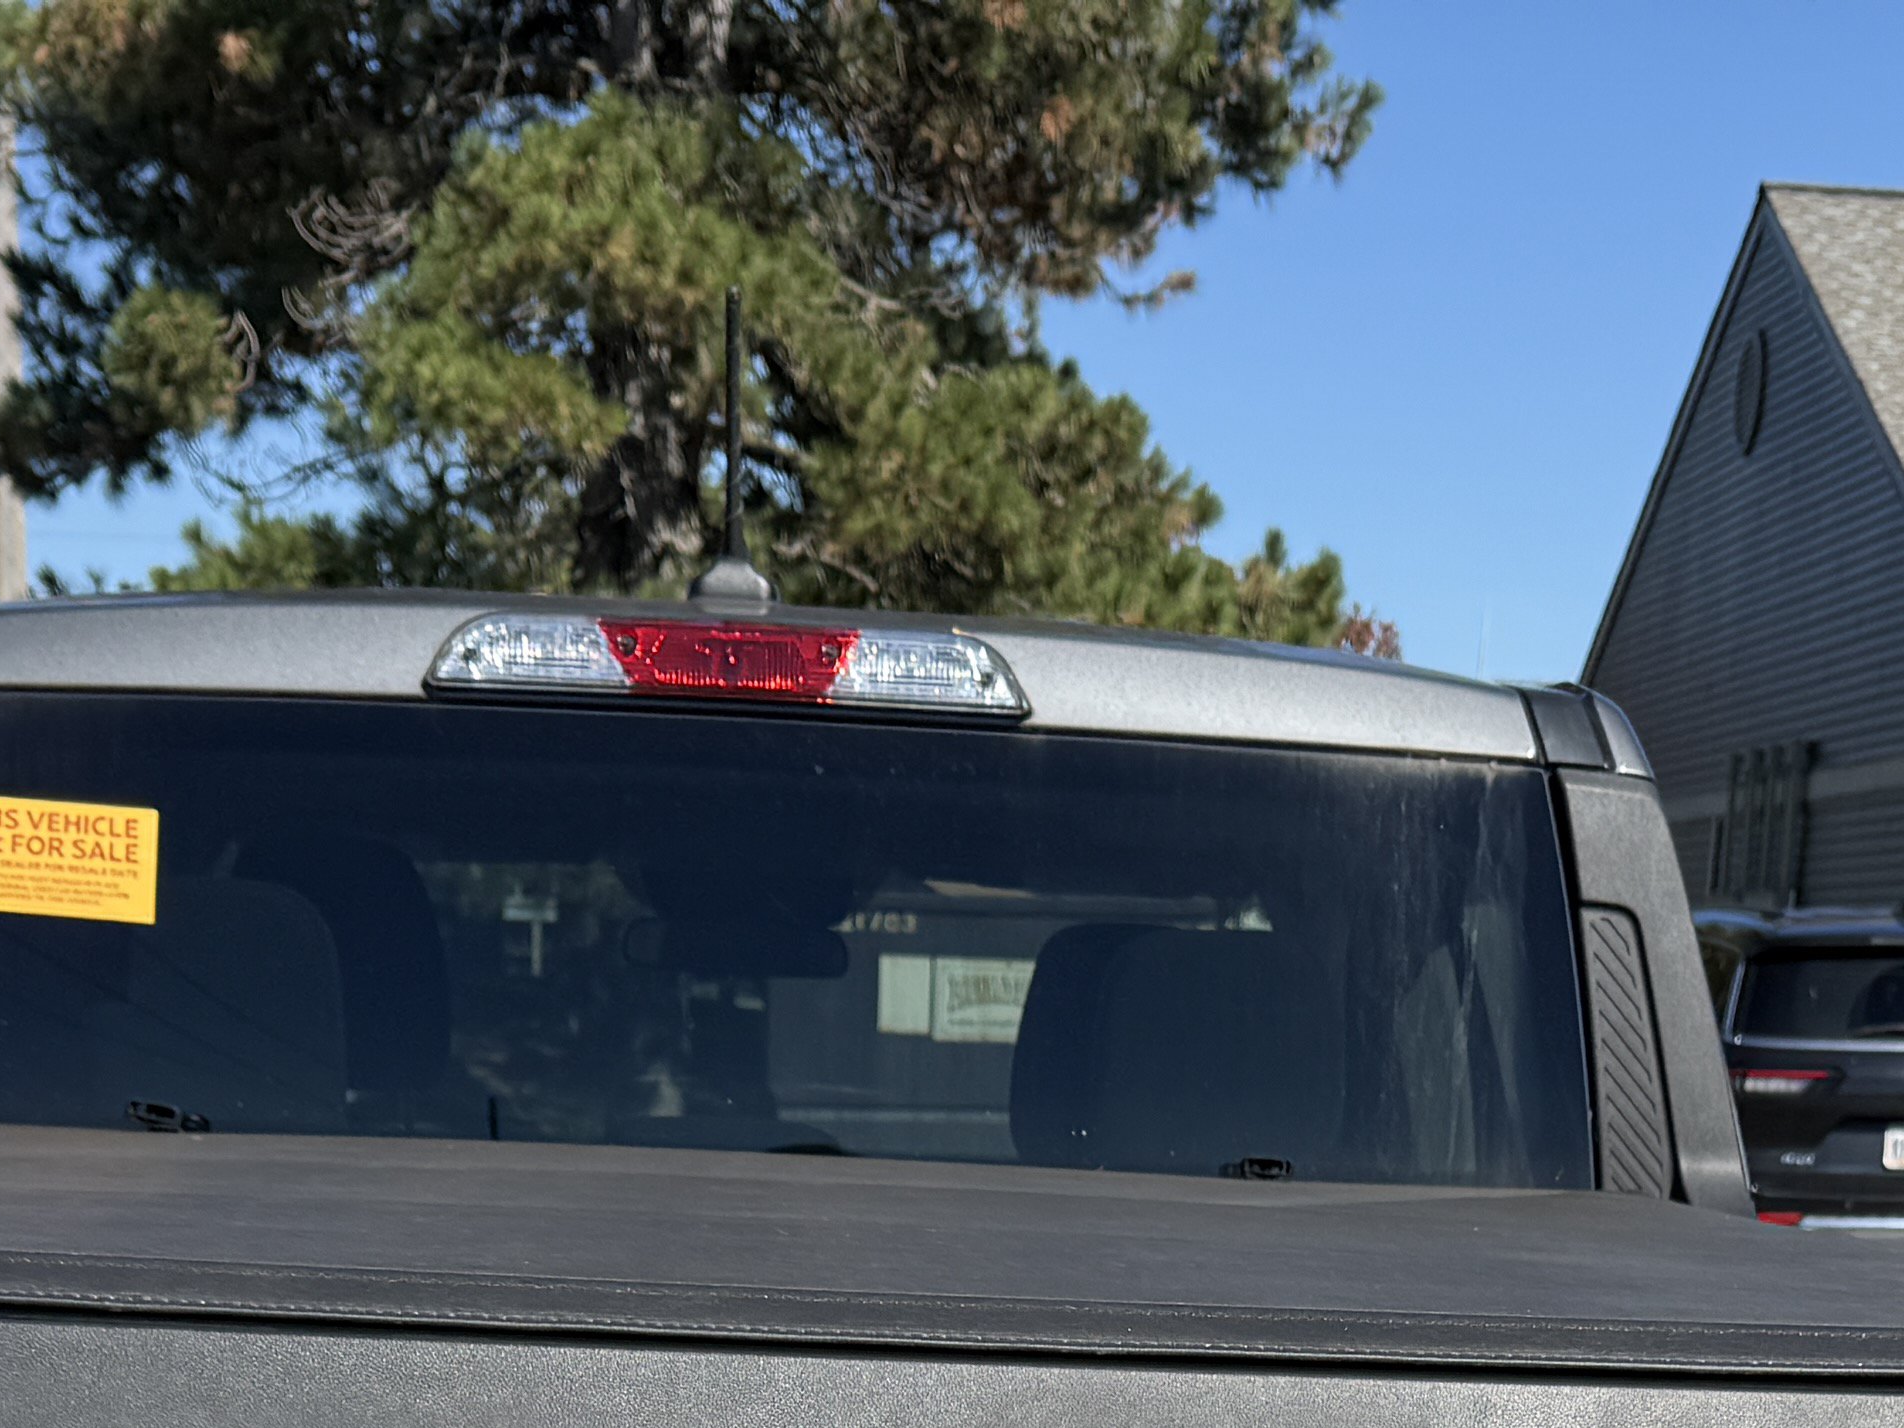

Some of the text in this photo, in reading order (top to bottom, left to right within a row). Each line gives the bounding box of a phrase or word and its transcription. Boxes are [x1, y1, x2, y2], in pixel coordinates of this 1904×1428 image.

[27, 810, 139, 839] VEHICLE
[11, 834, 64, 858] FOR
[72, 839, 139, 863] SALE
